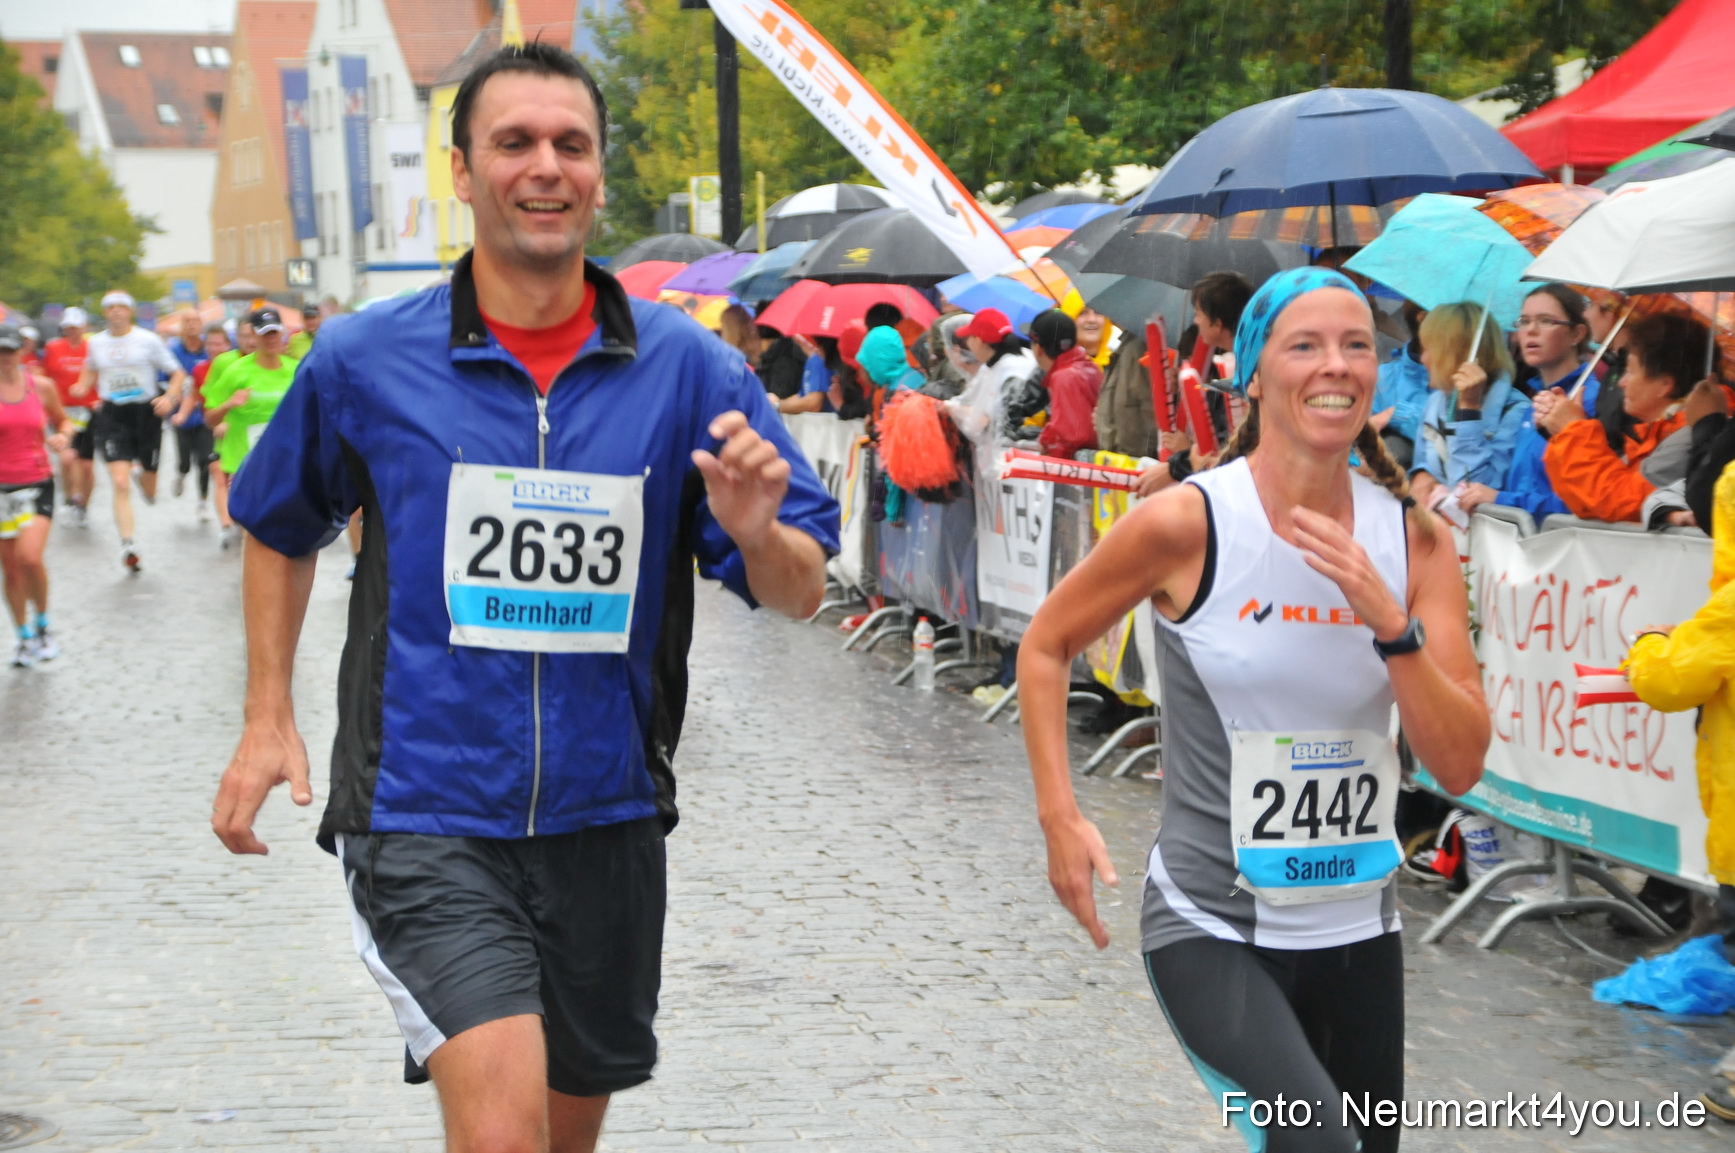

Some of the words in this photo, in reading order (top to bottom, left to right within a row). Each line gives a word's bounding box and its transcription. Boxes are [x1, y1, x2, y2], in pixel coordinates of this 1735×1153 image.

[512, 480, 591, 502] BOCK
[467, 516, 625, 586] 2633
[485, 596, 593, 626] Bernhard
[1538, 680, 1674, 782] BESSER
[1292, 740, 1353, 760] BOCK
[1252, 773, 1379, 840] 2442
[1285, 855, 1356, 881] Sandra
